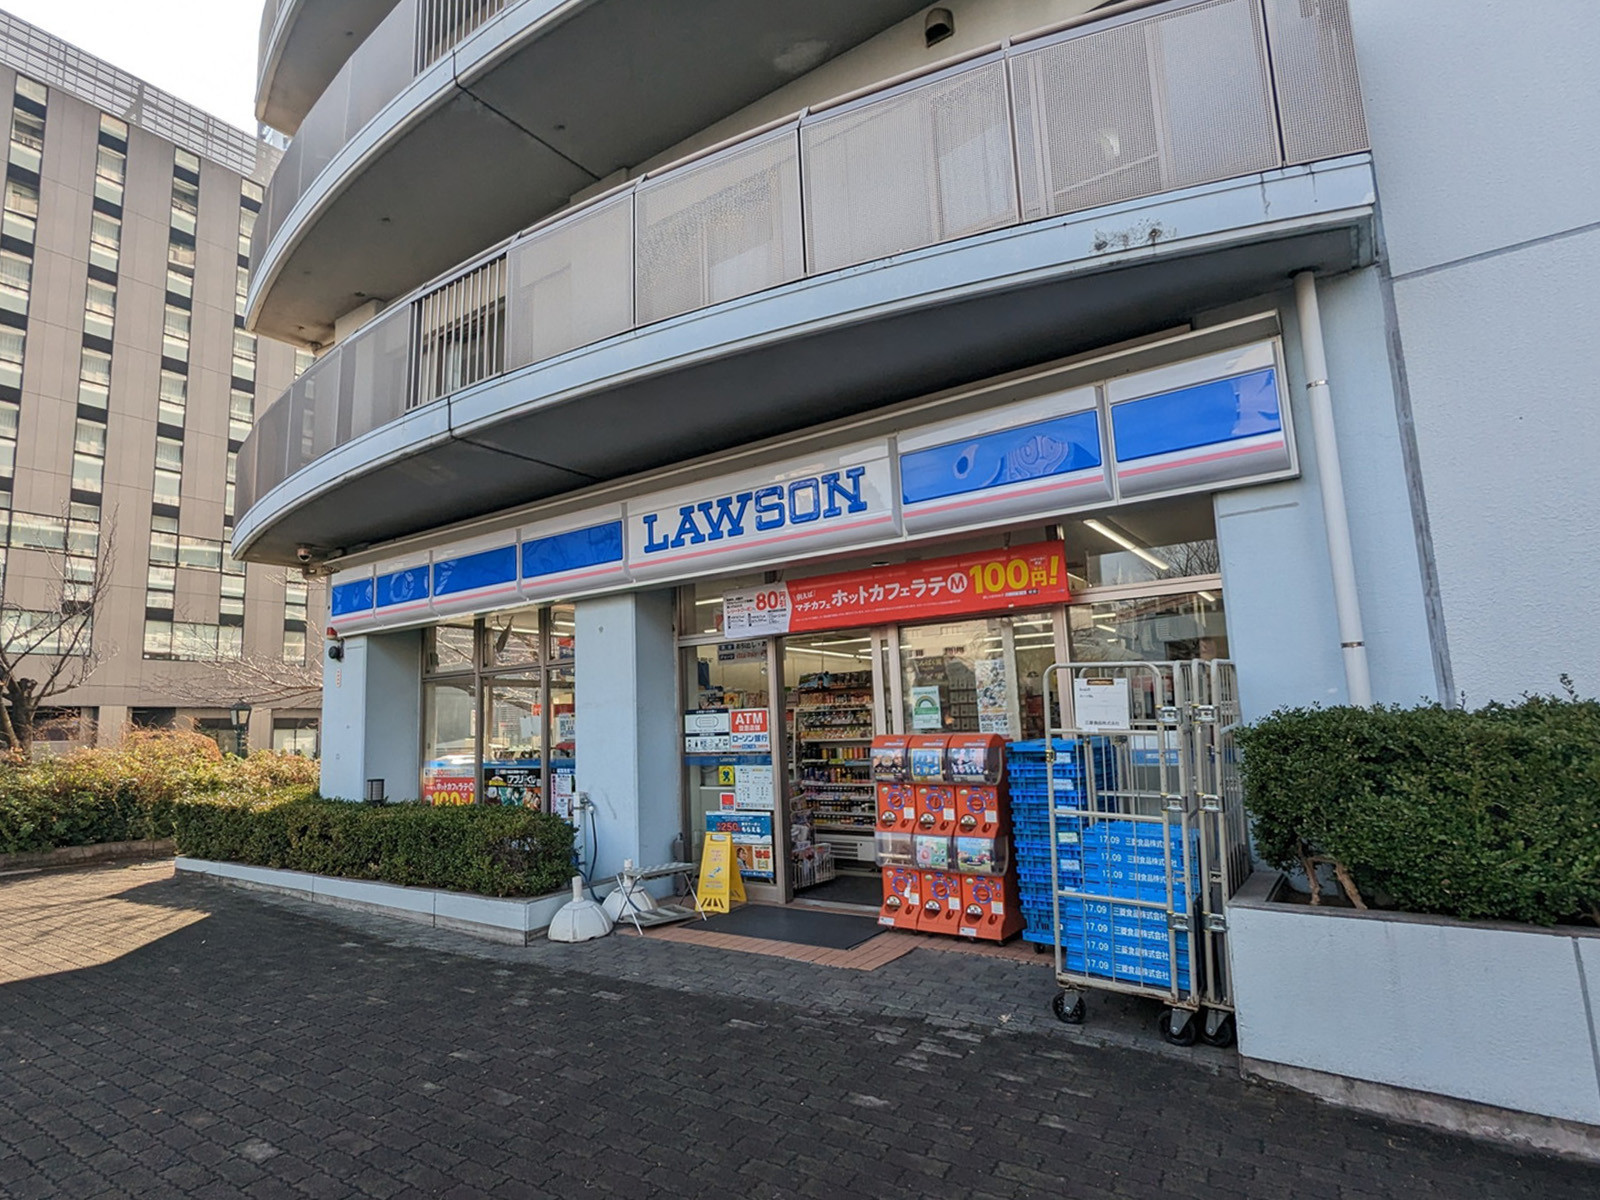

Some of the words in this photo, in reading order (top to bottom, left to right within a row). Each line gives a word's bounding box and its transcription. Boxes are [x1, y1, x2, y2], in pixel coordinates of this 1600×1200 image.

[643, 466, 868, 553] LAWSON
[832, 577, 946, 607] ホットカフェラテ
[735, 712, 763, 725] ATM
[732, 734, 768, 743] ローソン銀行
[1084, 903, 1107, 914] 17.09
[1113, 906, 1167, 921] 三菱食品株式会社
[1086, 922, 1108, 933] 17.09
[1114, 925, 1168, 941] 三菱食品株式会社
[1086, 941, 1109, 951] 17.09
[1115, 944, 1169, 960] 三菱食品株式会社
[1086, 959, 1109, 970] 17.09
[1115, 963, 1169, 980] 三菱食品株式会社
